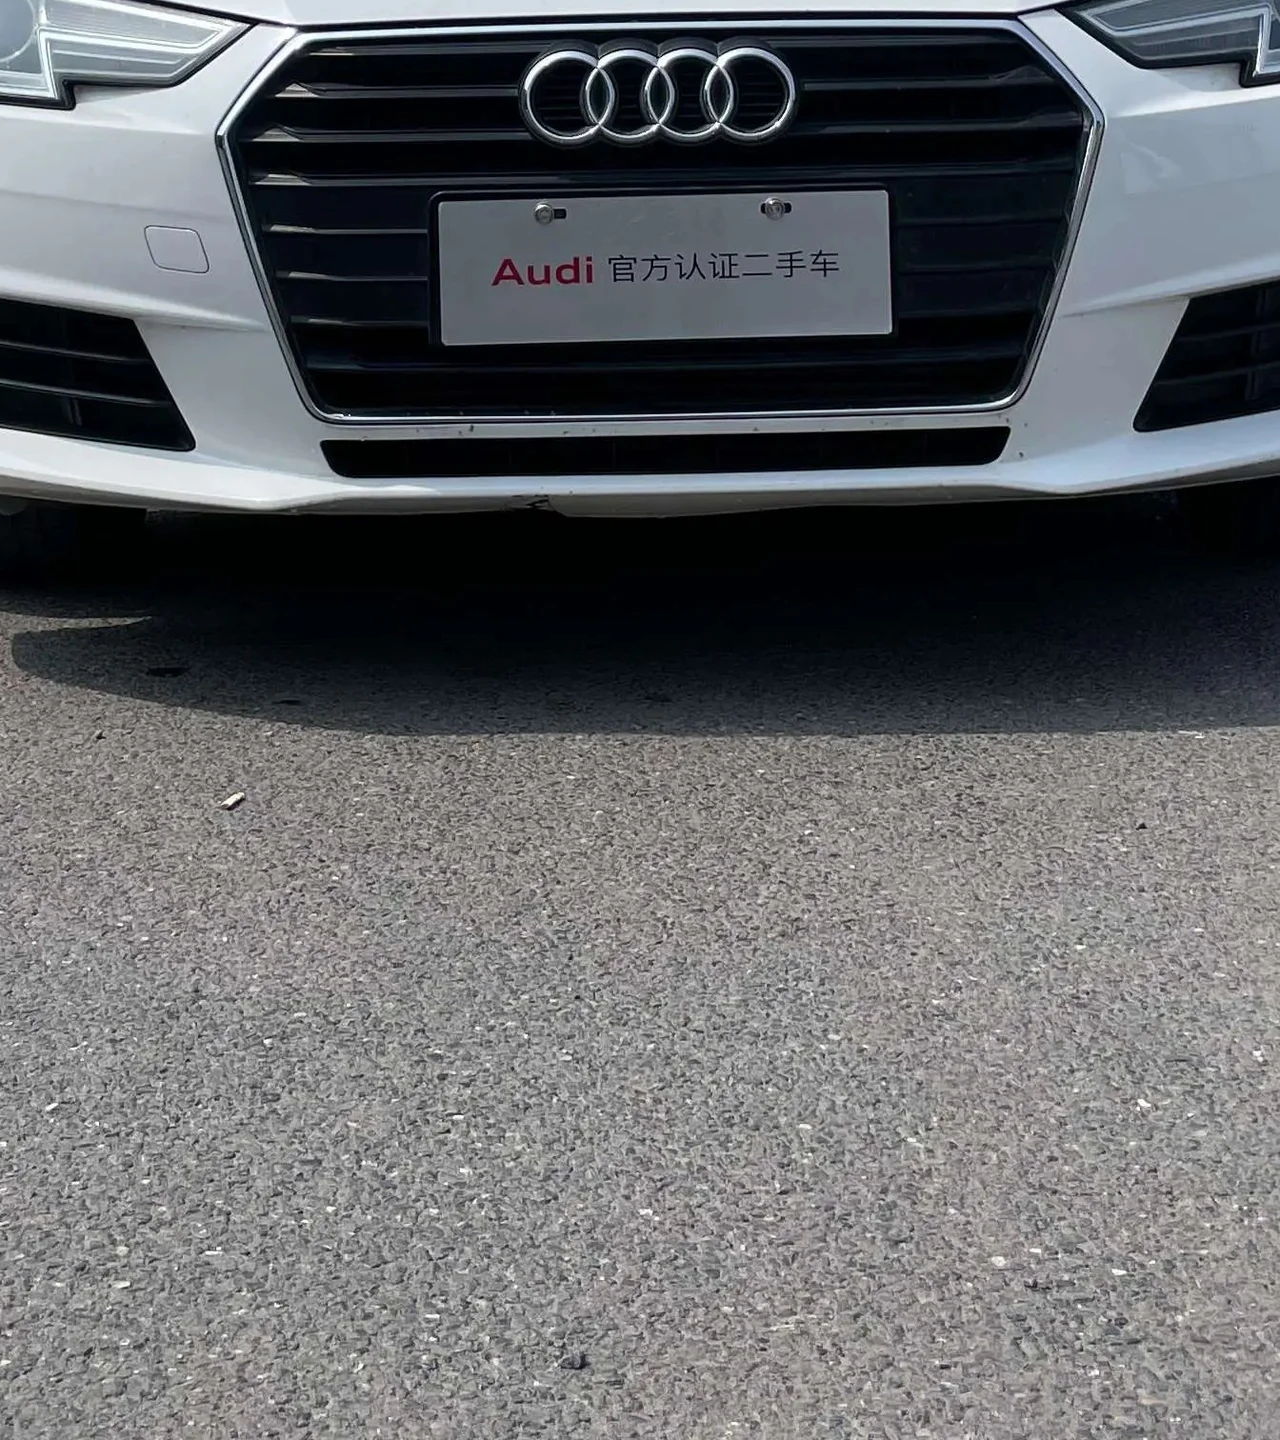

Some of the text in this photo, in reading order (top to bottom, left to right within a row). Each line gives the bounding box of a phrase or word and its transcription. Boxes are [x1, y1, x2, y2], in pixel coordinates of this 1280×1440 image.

[492, 250, 841, 287] Audi 官方认证二手车
